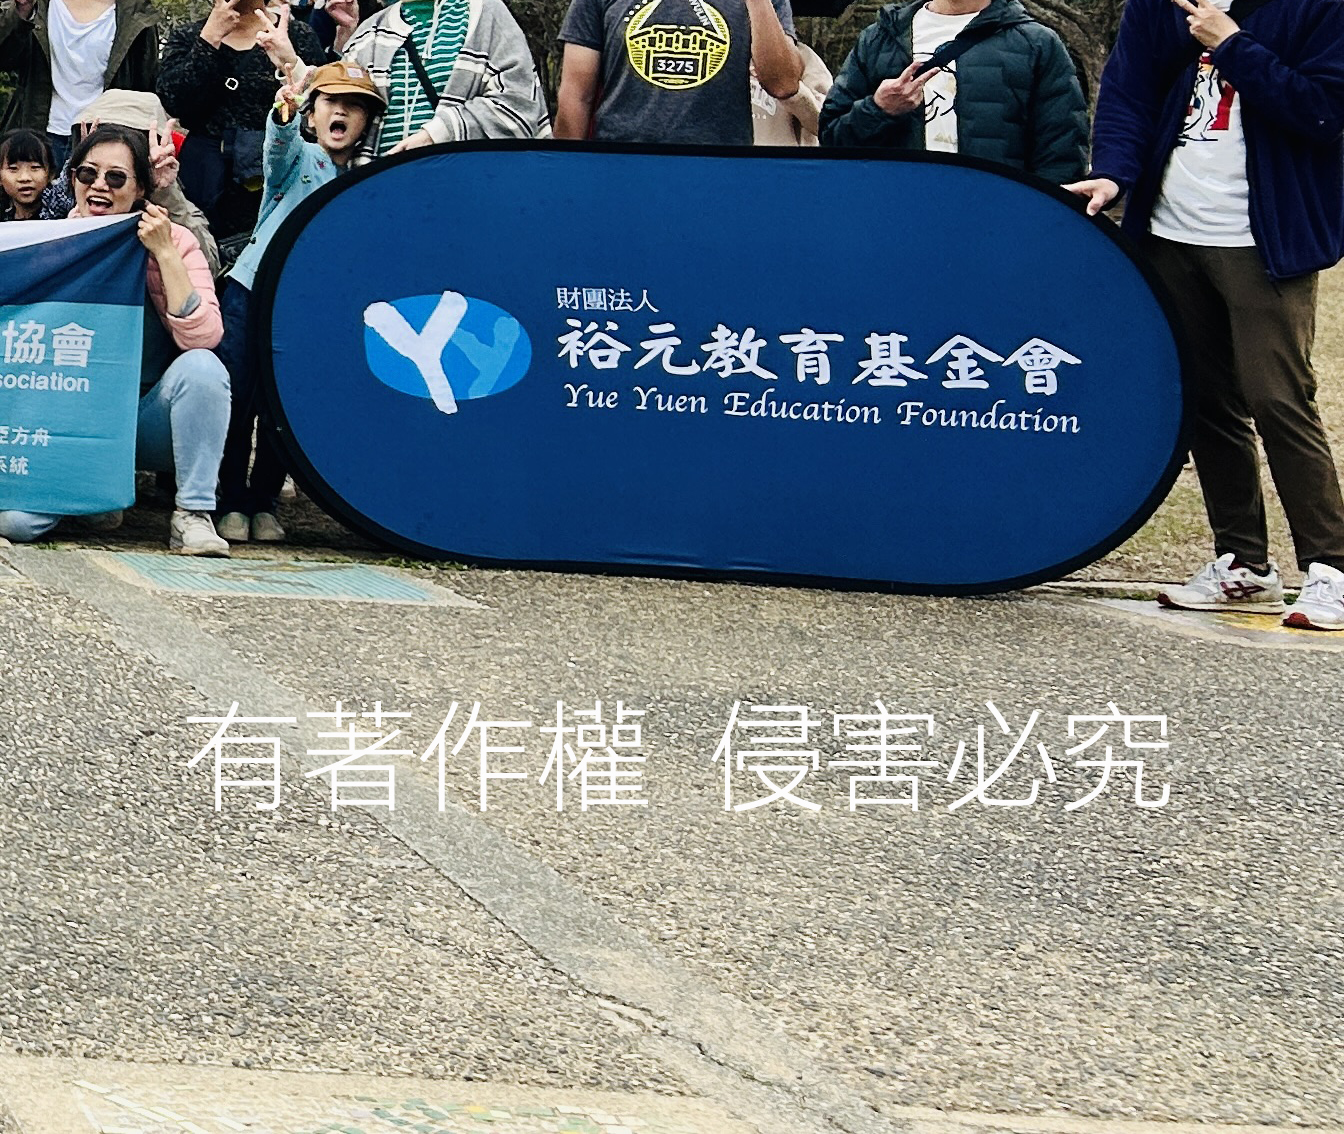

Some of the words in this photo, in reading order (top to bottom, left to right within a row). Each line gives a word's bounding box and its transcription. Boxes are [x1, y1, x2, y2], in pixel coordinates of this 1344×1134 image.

[657, 60, 694, 73] 3275
[556, 287, 660, 313] 財團法人
[557, 318, 1082, 396] 裕元教育基金會
[564, 383, 619, 408] Yue
[633, 386, 709, 415] Yuen
[724, 388, 882, 425] Education
[896, 399, 1081, 434] Foundation
